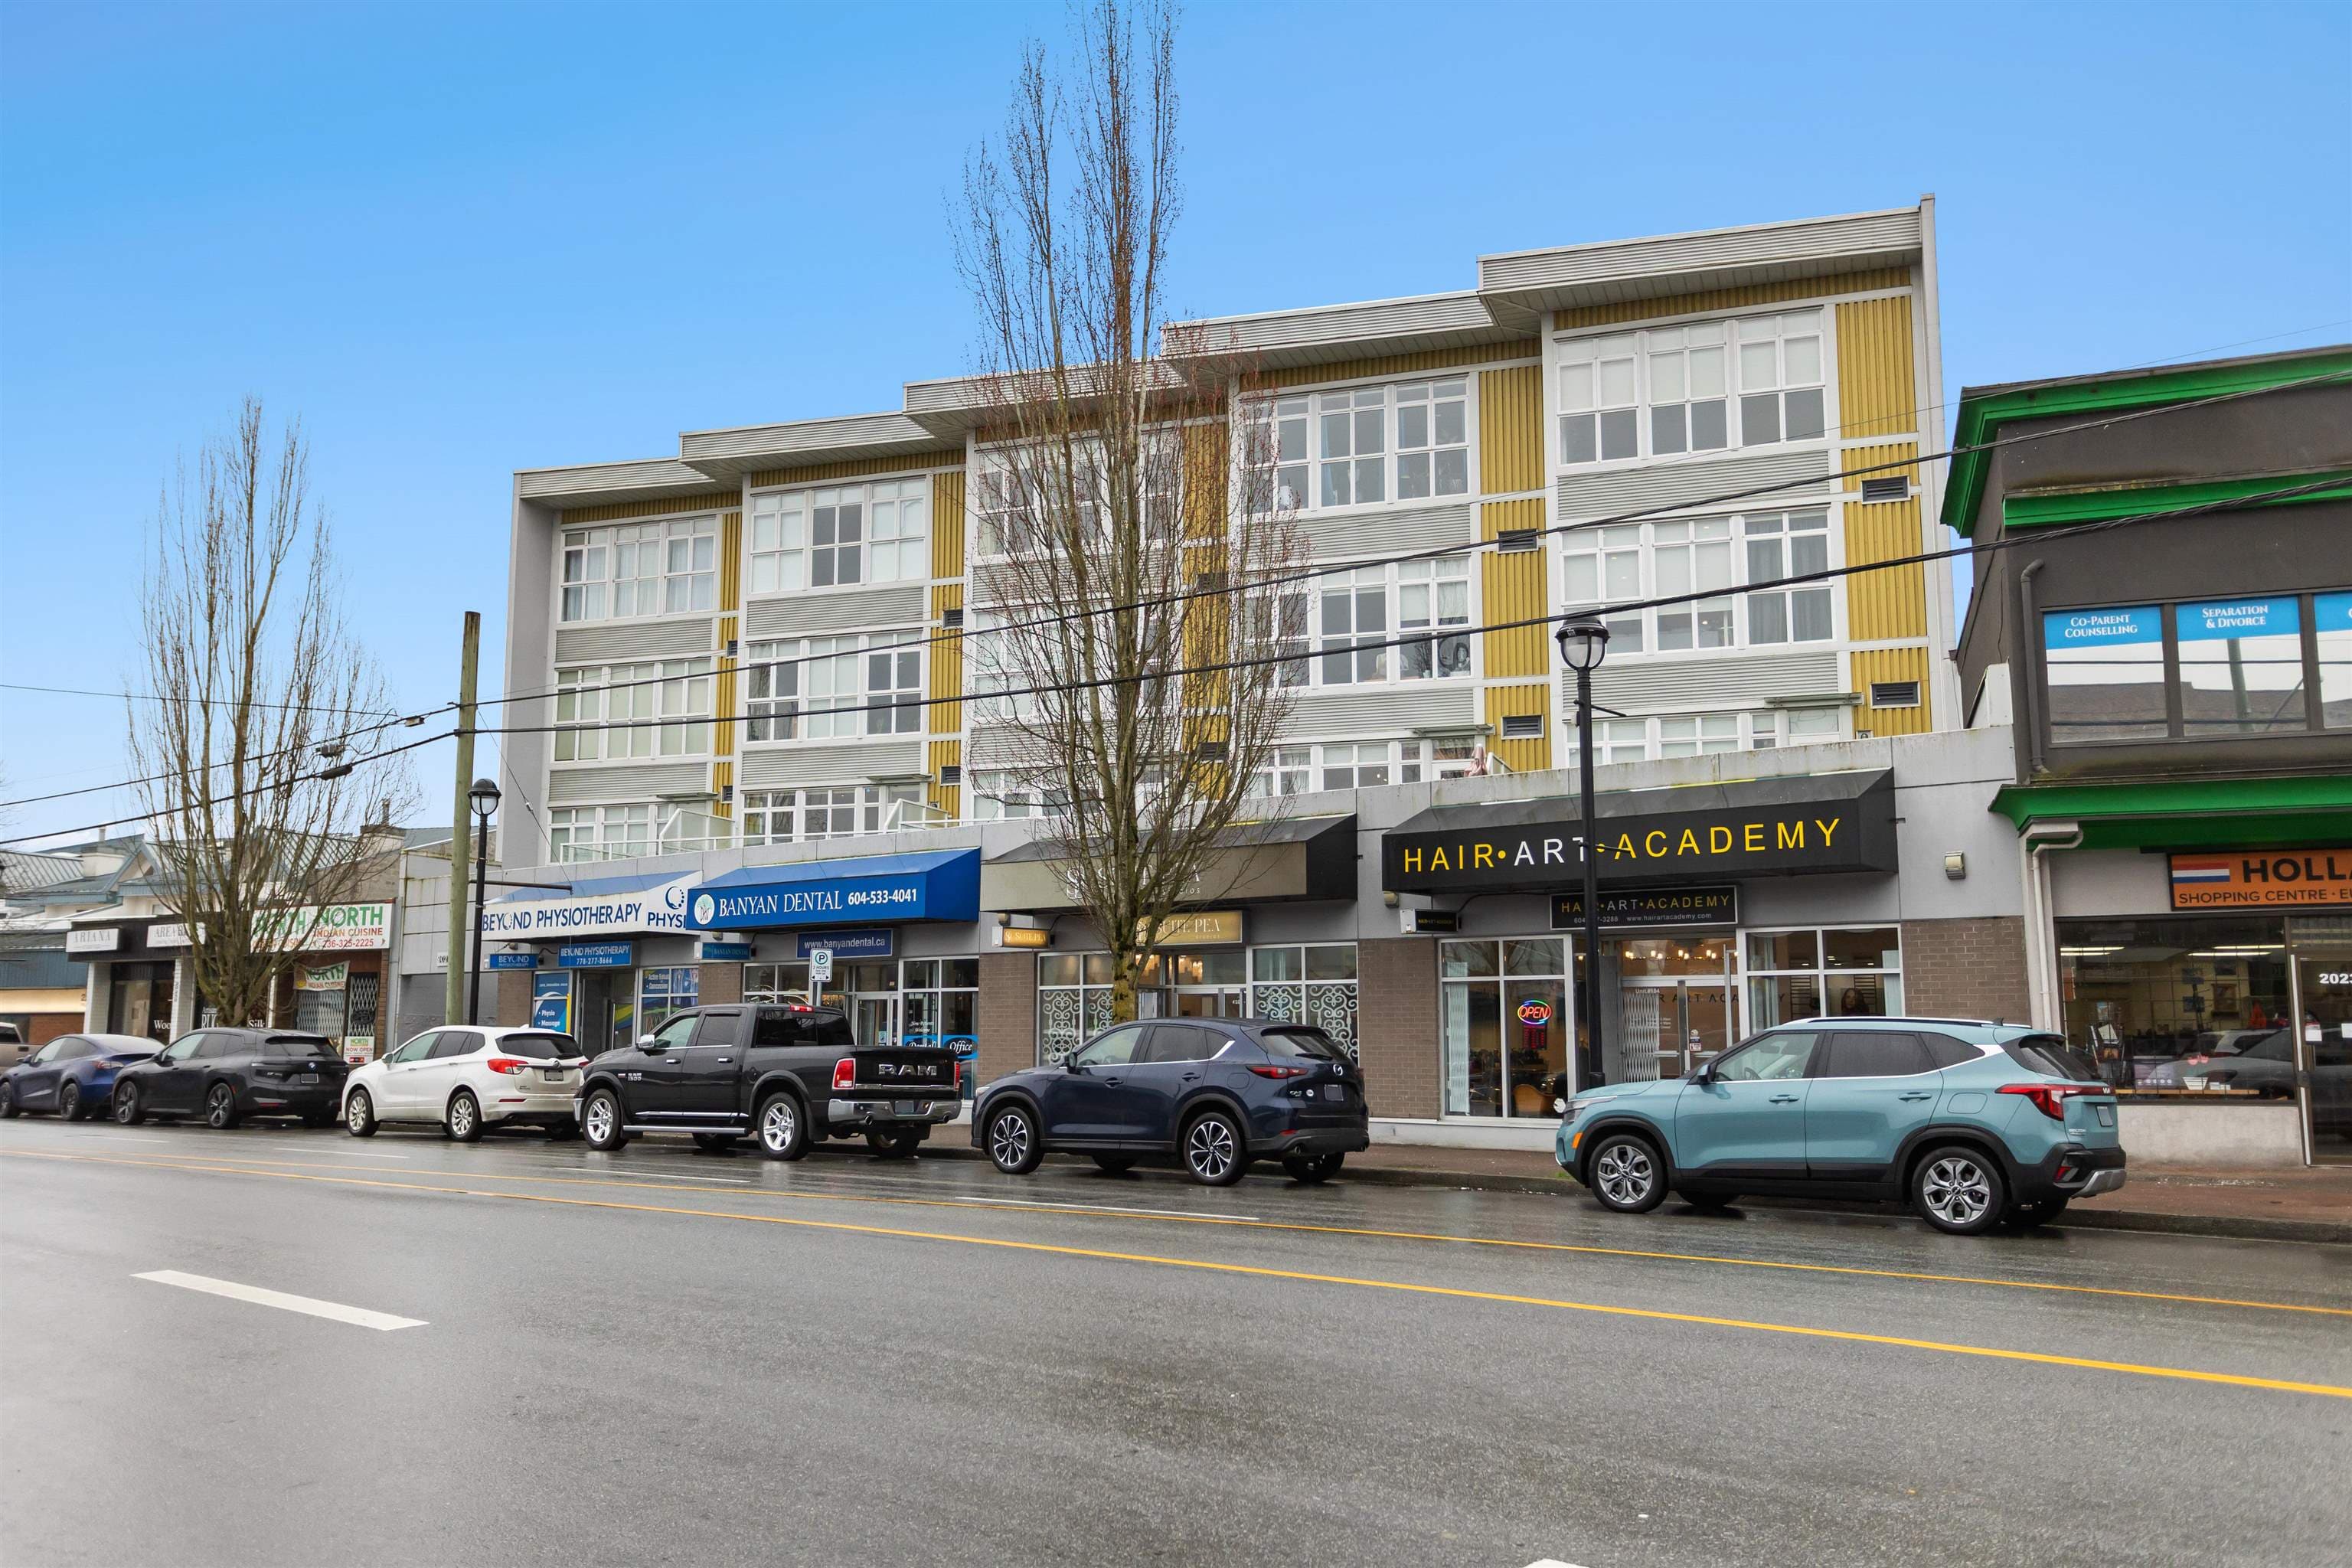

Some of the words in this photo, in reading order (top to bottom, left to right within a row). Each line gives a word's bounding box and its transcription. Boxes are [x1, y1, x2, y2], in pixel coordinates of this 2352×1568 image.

[2202, 605, 2268, 618] SEPARATION
[2206, 618, 2215, 629] &
[2217, 616, 2266, 627] DIVORCE
[2065, 625, 2138, 638] COUNSELLING
[1404, 843, 1494, 873] HAIR
[1614, 818, 1840, 860] ACADEMY
[2243, 857, 2352, 883] HOLL
[719, 894, 777, 917] BANYAN
[783, 891, 843, 913] DENTAL
[848, 888, 917, 906] 604-533-4041
[1606, 899, 1638, 911] ART
[1646, 895, 1730, 910] ACADEMY
[2179, 890, 2260, 903] SHOPPING
[2265, 889, 2327, 901] CENTRE
[320, 906, 383, 927] NORTH
[482, 910, 531, 932] BEYOND
[537, 903, 642, 928] PHYSIOTHERAPY
[1626, 912, 1712, 921] www.hairartacademy.com
[348, 928, 383, 936] CUISINE
[1194, 918, 1221, 933] PEA
[322, 939, 374, 948] 236-325-2225
[804, 936, 885, 950] www.banyandental.ca
[560, 946, 583, 956] BEYOND
[584, 945, 629, 956] PHYSIOTHERAPY
[306, 965, 345, 980] NORTH
[1520, 1006, 1548, 1018] OPEN
[949, 1040, 972, 1054] Office
[878, 1063, 937, 1076] RAM
